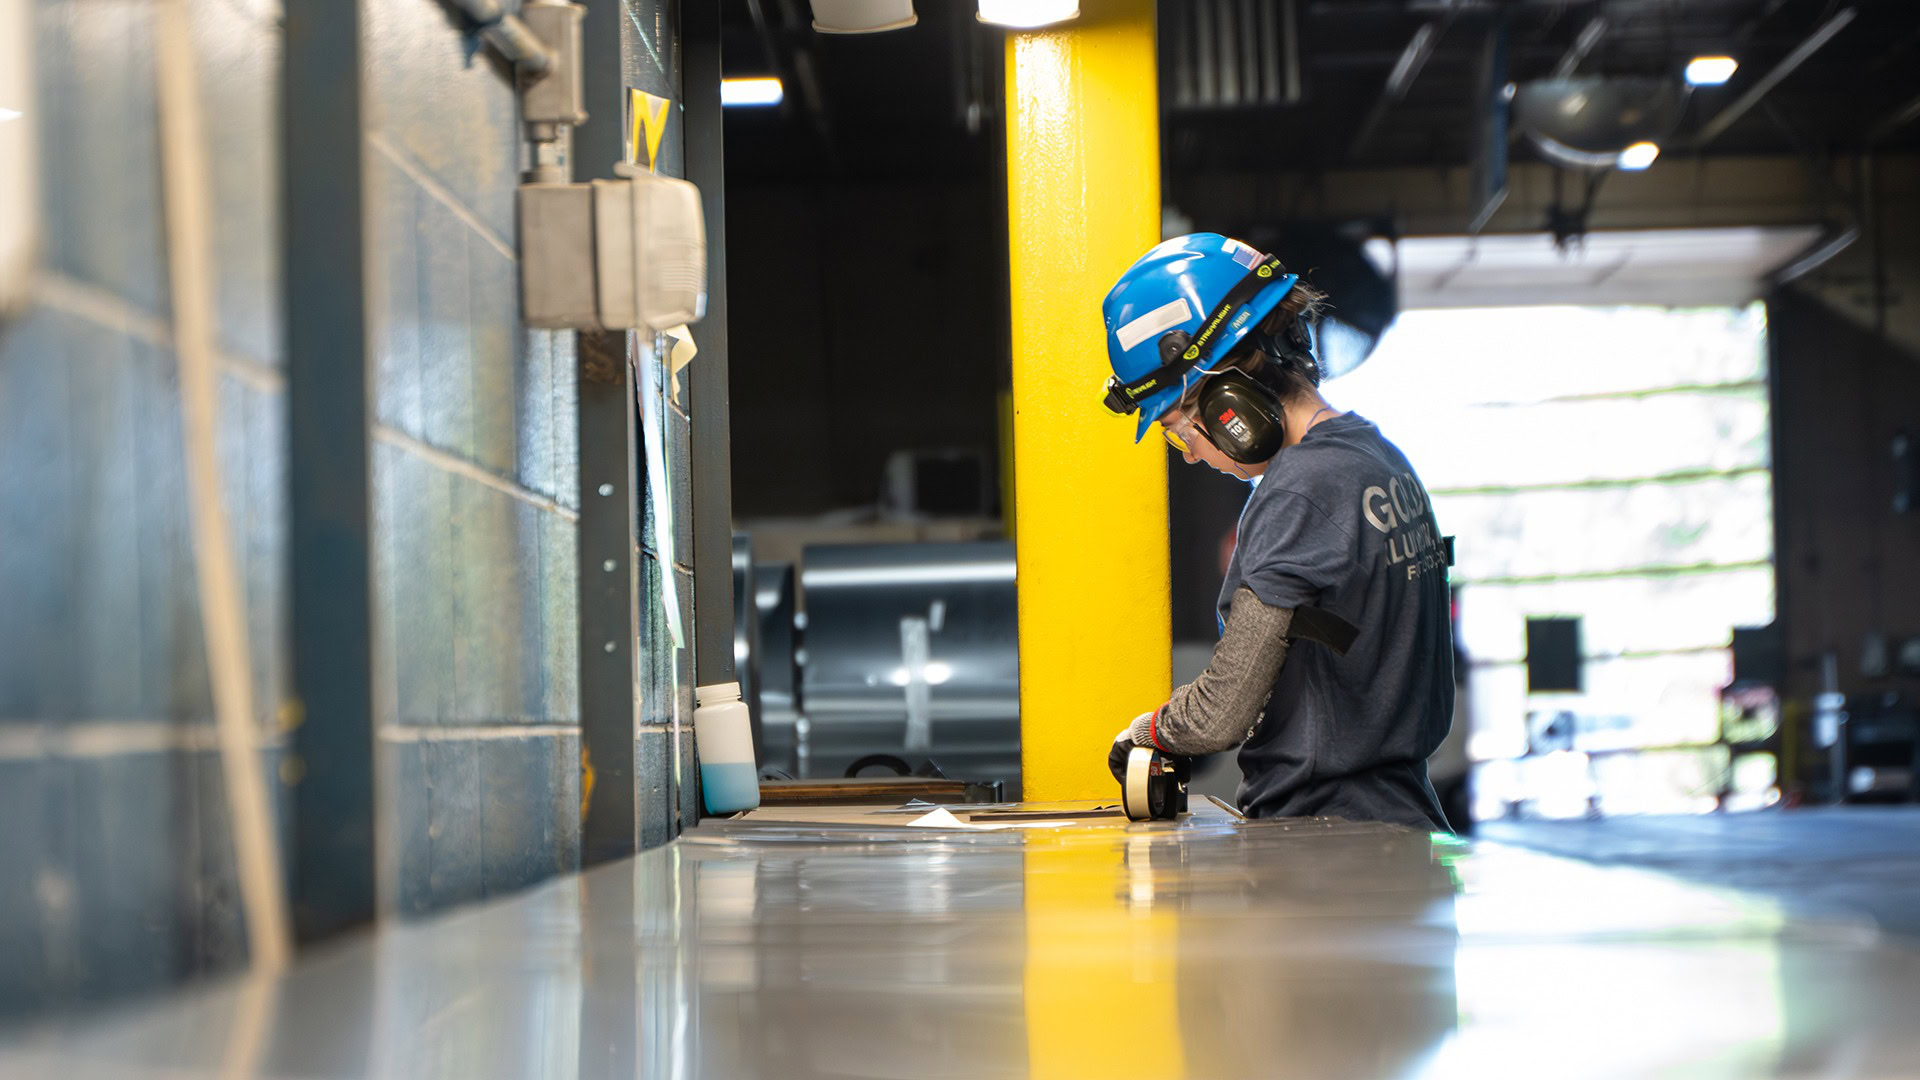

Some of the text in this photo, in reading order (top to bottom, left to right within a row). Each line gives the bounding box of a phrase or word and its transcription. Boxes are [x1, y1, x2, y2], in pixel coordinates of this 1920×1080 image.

[1197, 303, 1232, 347] STREAMLIGHT
[1218, 408, 1236, 425] 3M
[1230, 421, 1246, 437] 101
